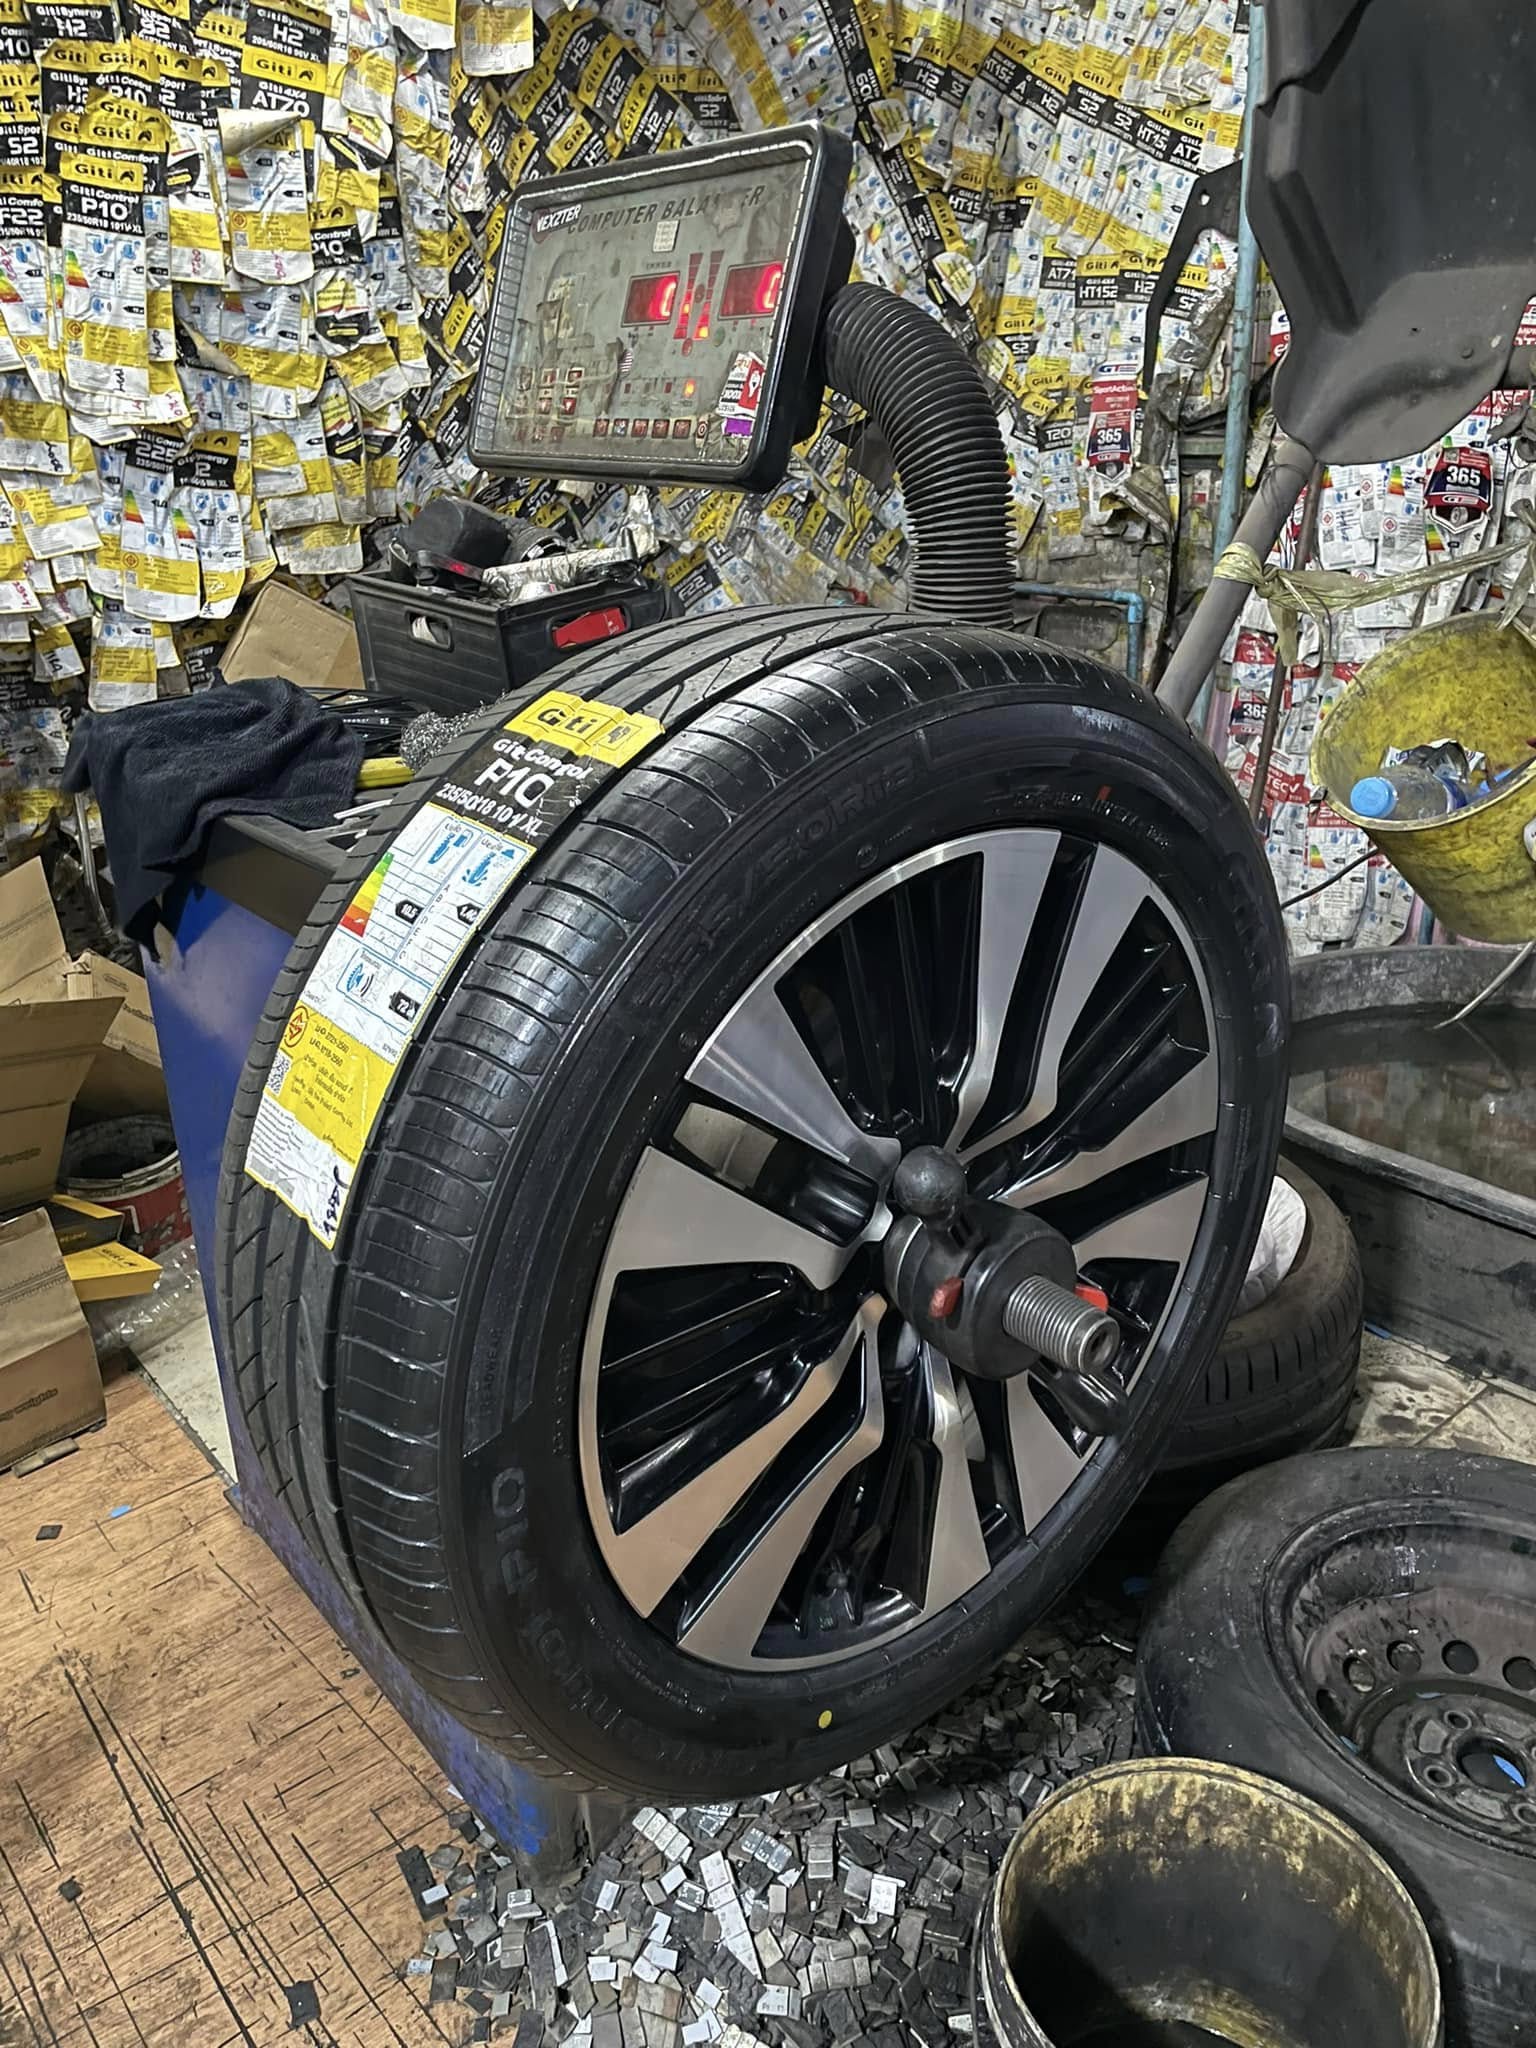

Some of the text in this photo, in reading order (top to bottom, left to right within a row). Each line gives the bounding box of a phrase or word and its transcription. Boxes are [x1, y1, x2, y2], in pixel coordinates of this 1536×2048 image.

[273, 24, 304, 47] H2
[552, 24, 568, 56] Giti
[840, 24, 857, 50] H2
[54, 50, 87, 63] Giti
[570, 36, 591, 66] H2
[256, 59, 292, 76] Giti
[1044, 66, 1066, 85] Giti
[2, 75, 22, 86] iti
[451, 71, 463, 86] Gi
[586, 64, 603, 93] Giti
[916, 68, 940, 90] H2
[1082, 70, 1104, 85] Giti
[521, 77, 543, 105] Giti
[605, 75, 626, 104] H2
[951, 81, 964, 98] S2
[100, 101, 138, 121] Giti
[700, 104, 720, 118] S2
[1040, 93, 1059, 115] H2
[1079, 98, 1100, 116] S2
[623, 100, 639, 130] Giti
[1114, 113, 1132, 131] S2
[1184, 117, 1205, 131] Git
[60, 121, 79, 134] Gi
[93, 126, 131, 140] Giti
[644, 111, 663, 140] H2
[8, 137, 39, 155] S2
[564, 123, 586, 151] Giti
[86, 148, 159, 164] GitiComfort
[584, 140, 606, 166] H2
[1172, 143, 1201, 164] AT7
[2, 173, 24, 184] iti
[75, 164, 113, 179] Giti
[887, 158, 903, 184] S2
[960, 172, 981, 184] Giti
[69, 185, 139, 203] GitiControl
[1025, 182, 1038, 191] Gi
[81, 198, 128, 221] P10
[935, 199, 947, 223] Giti
[948, 195, 981, 215] HT15
[0, 208, 44, 225] F22
[567, 203, 660, 234] COMPUTER
[314, 228, 352, 240] Control
[914, 214, 931, 239] S2
[1085, 261, 1107, 270] Giti
[1080, 285, 1118, 298] HT152
[1134, 280, 1156, 293] H2
[448, 309, 465, 336] Giti
[1004, 320, 1025, 328] Giti
[466, 320, 485, 359] AT7
[1032, 376, 1053, 386] Giti
[1032, 401, 1049, 412] Git
[442, 420, 460, 447] S2
[1097, 428, 1122, 444] 365
[1446, 465, 1480, 486] 365
[679, 574, 707, 601] F22
[537, 708, 597, 734] Gti
[474, 758, 554, 808] P10
[520, 815, 544, 837] XL
